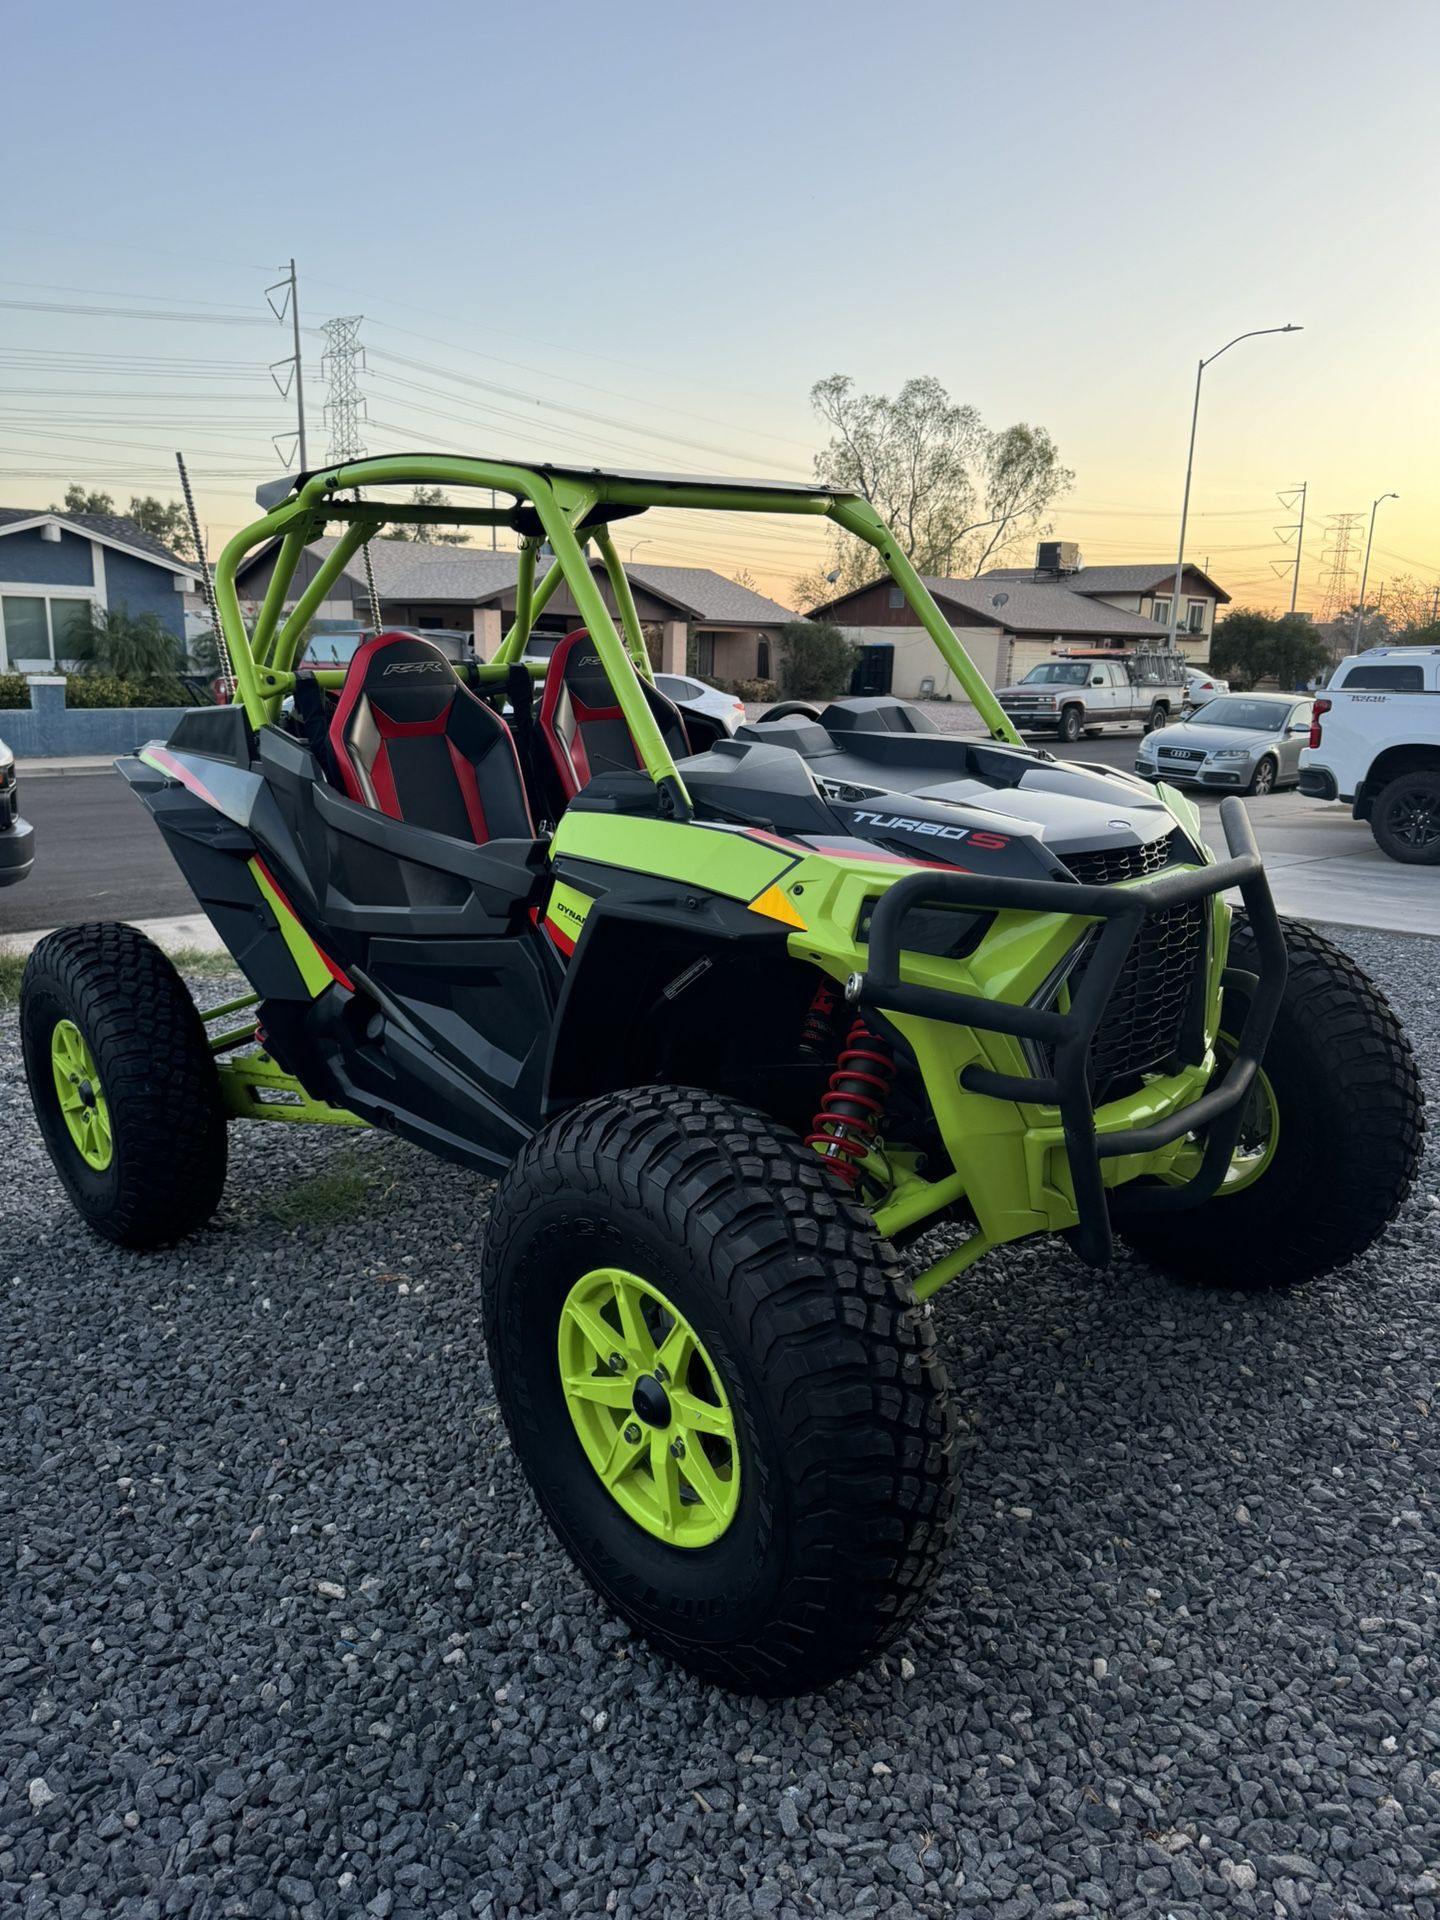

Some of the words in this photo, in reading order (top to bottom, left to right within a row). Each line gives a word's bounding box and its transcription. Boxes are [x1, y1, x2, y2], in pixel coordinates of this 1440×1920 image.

[383, 661, 442, 675] RZR
[853, 811, 970, 841] TURBO
[966, 832, 1010, 850] S
